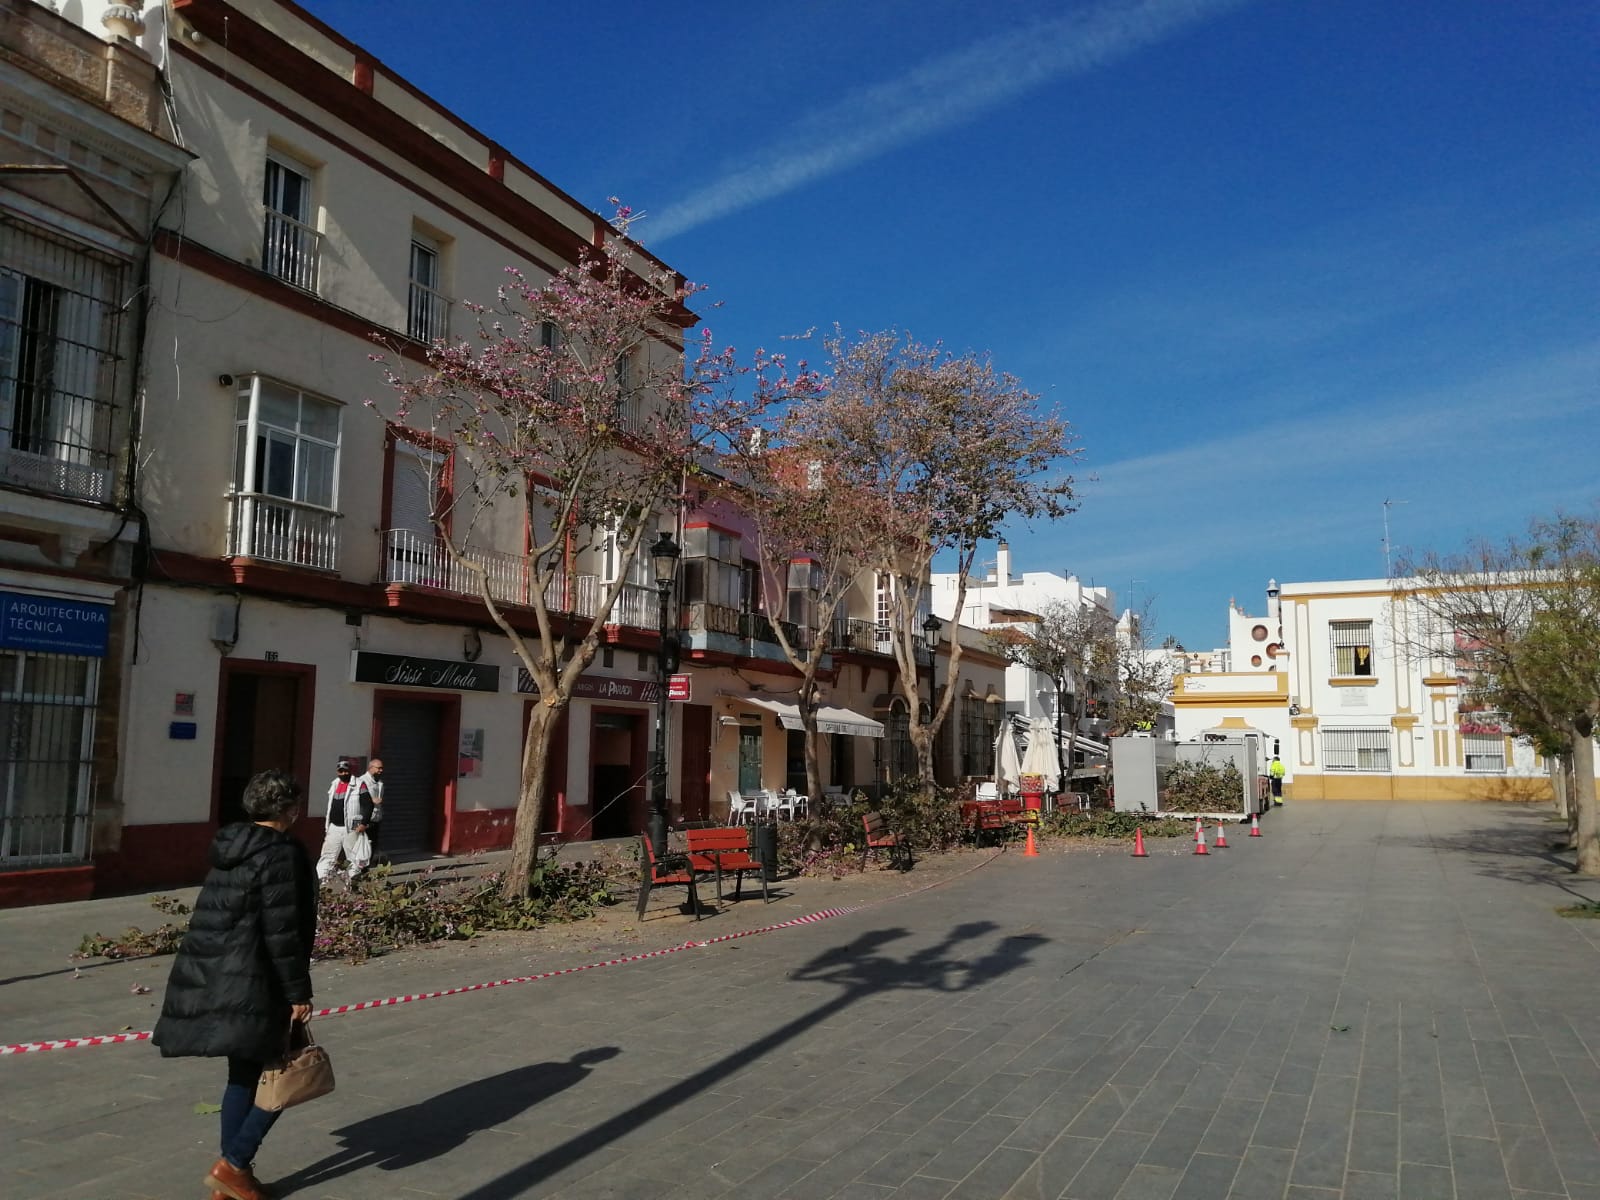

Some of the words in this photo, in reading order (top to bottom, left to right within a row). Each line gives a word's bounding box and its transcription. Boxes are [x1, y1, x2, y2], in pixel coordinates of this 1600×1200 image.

[10, 602, 105, 623] ARQUITECTURA
[9, 616, 63, 633] TÉCNICA
[385, 658, 426, 683] Sissi
[431, 664, 478, 687] Moda
